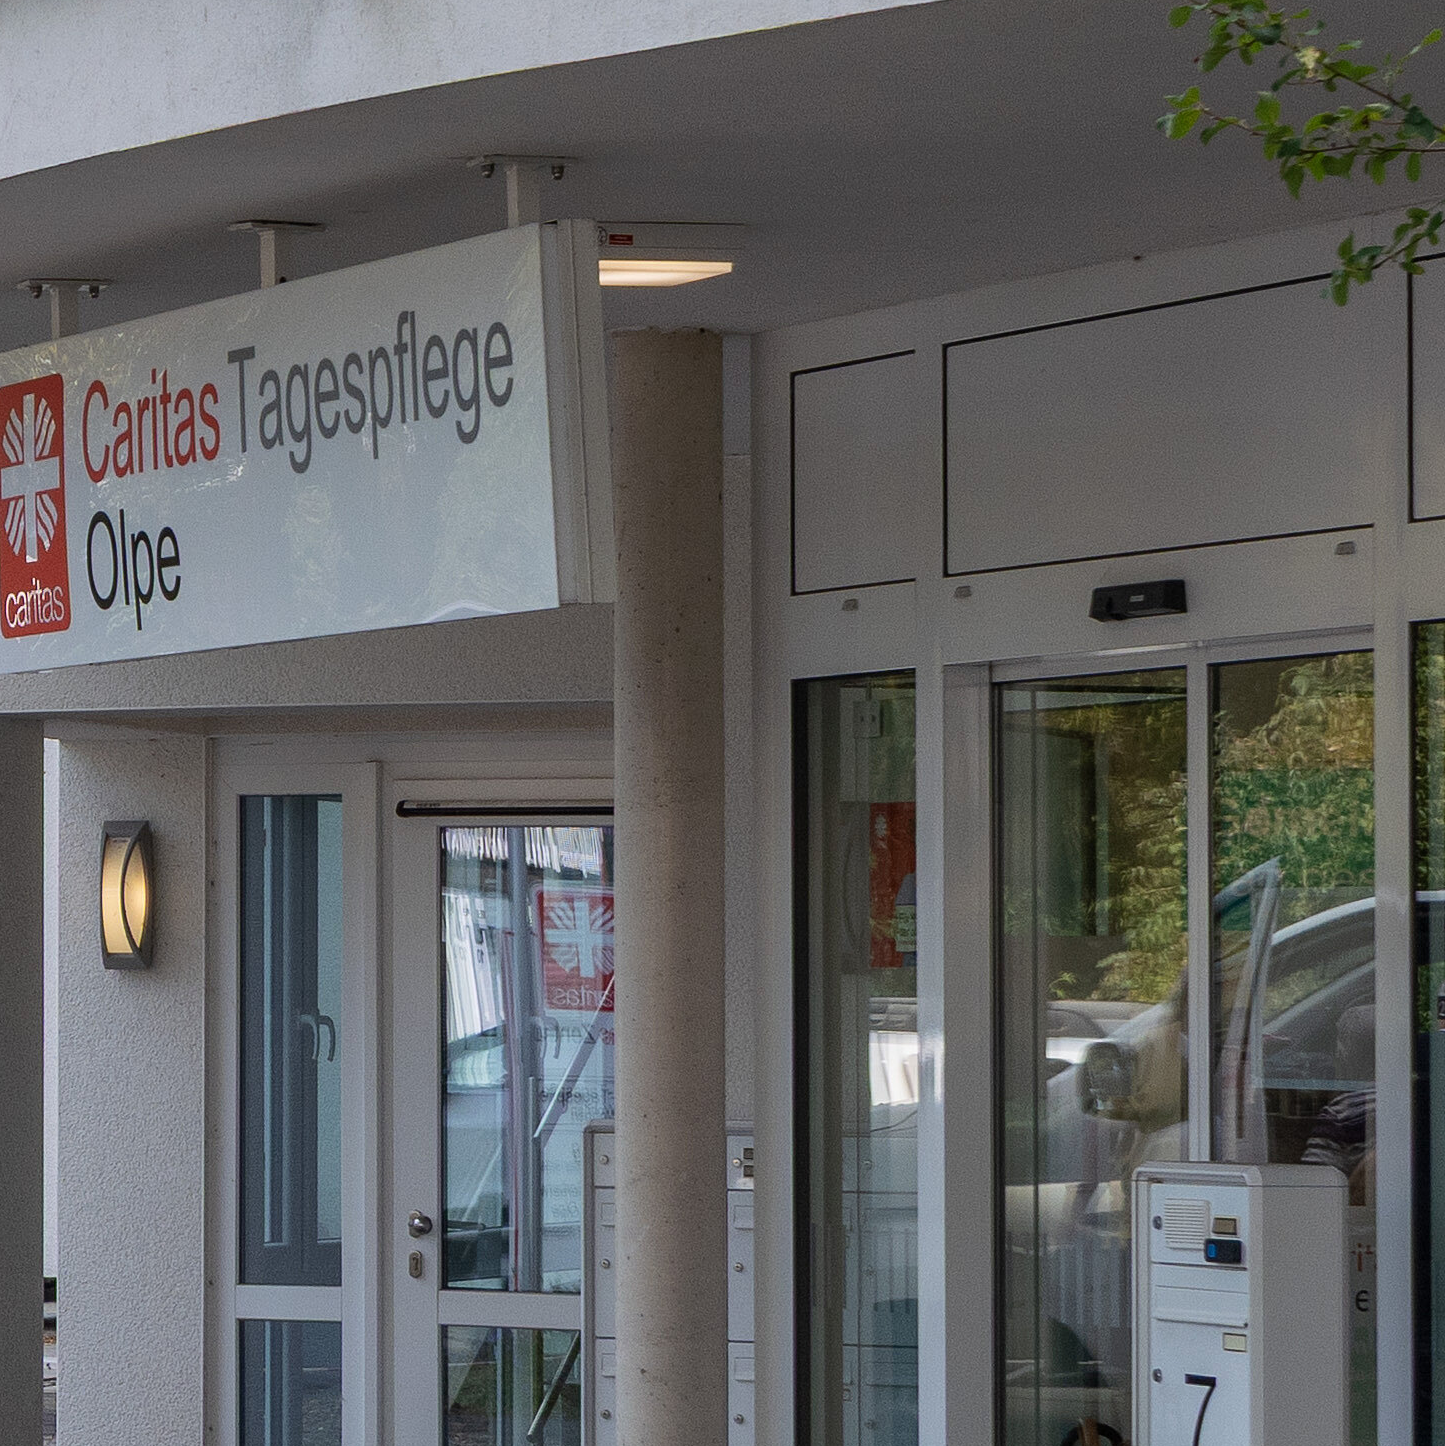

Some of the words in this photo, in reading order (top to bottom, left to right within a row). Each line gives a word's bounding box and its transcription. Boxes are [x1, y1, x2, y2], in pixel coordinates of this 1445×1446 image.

[81, 368, 221, 484] Caritas
[227, 310, 514, 474] Tagespflege
[4, 578, 65, 629] caritas
[85, 509, 181, 630] Olpe
